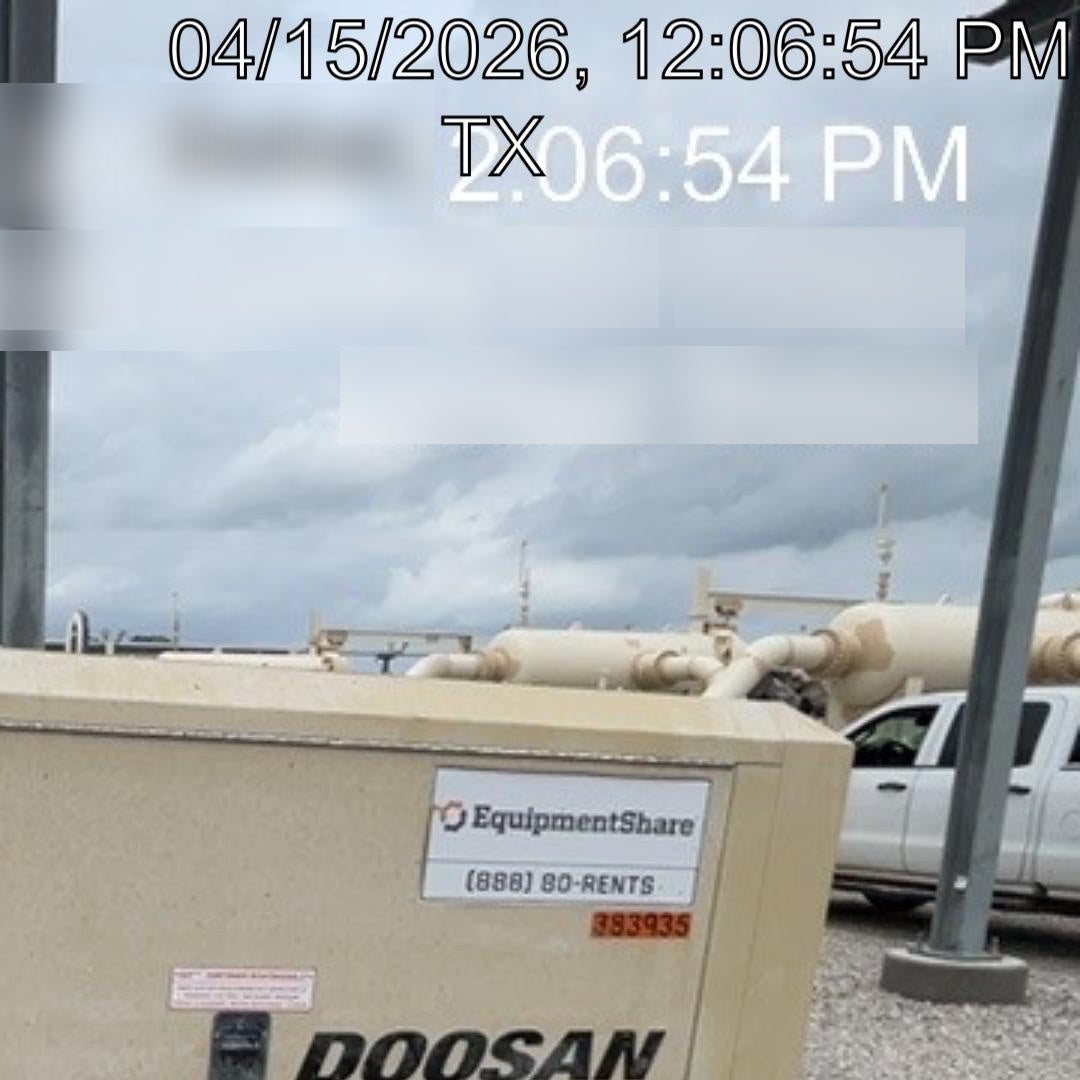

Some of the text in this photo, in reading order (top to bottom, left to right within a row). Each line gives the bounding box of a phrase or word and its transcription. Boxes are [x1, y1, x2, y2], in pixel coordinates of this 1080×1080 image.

[472, 804, 696, 837] EquipmentShare
[465, 869, 655, 896] (888) 80-RENTS
